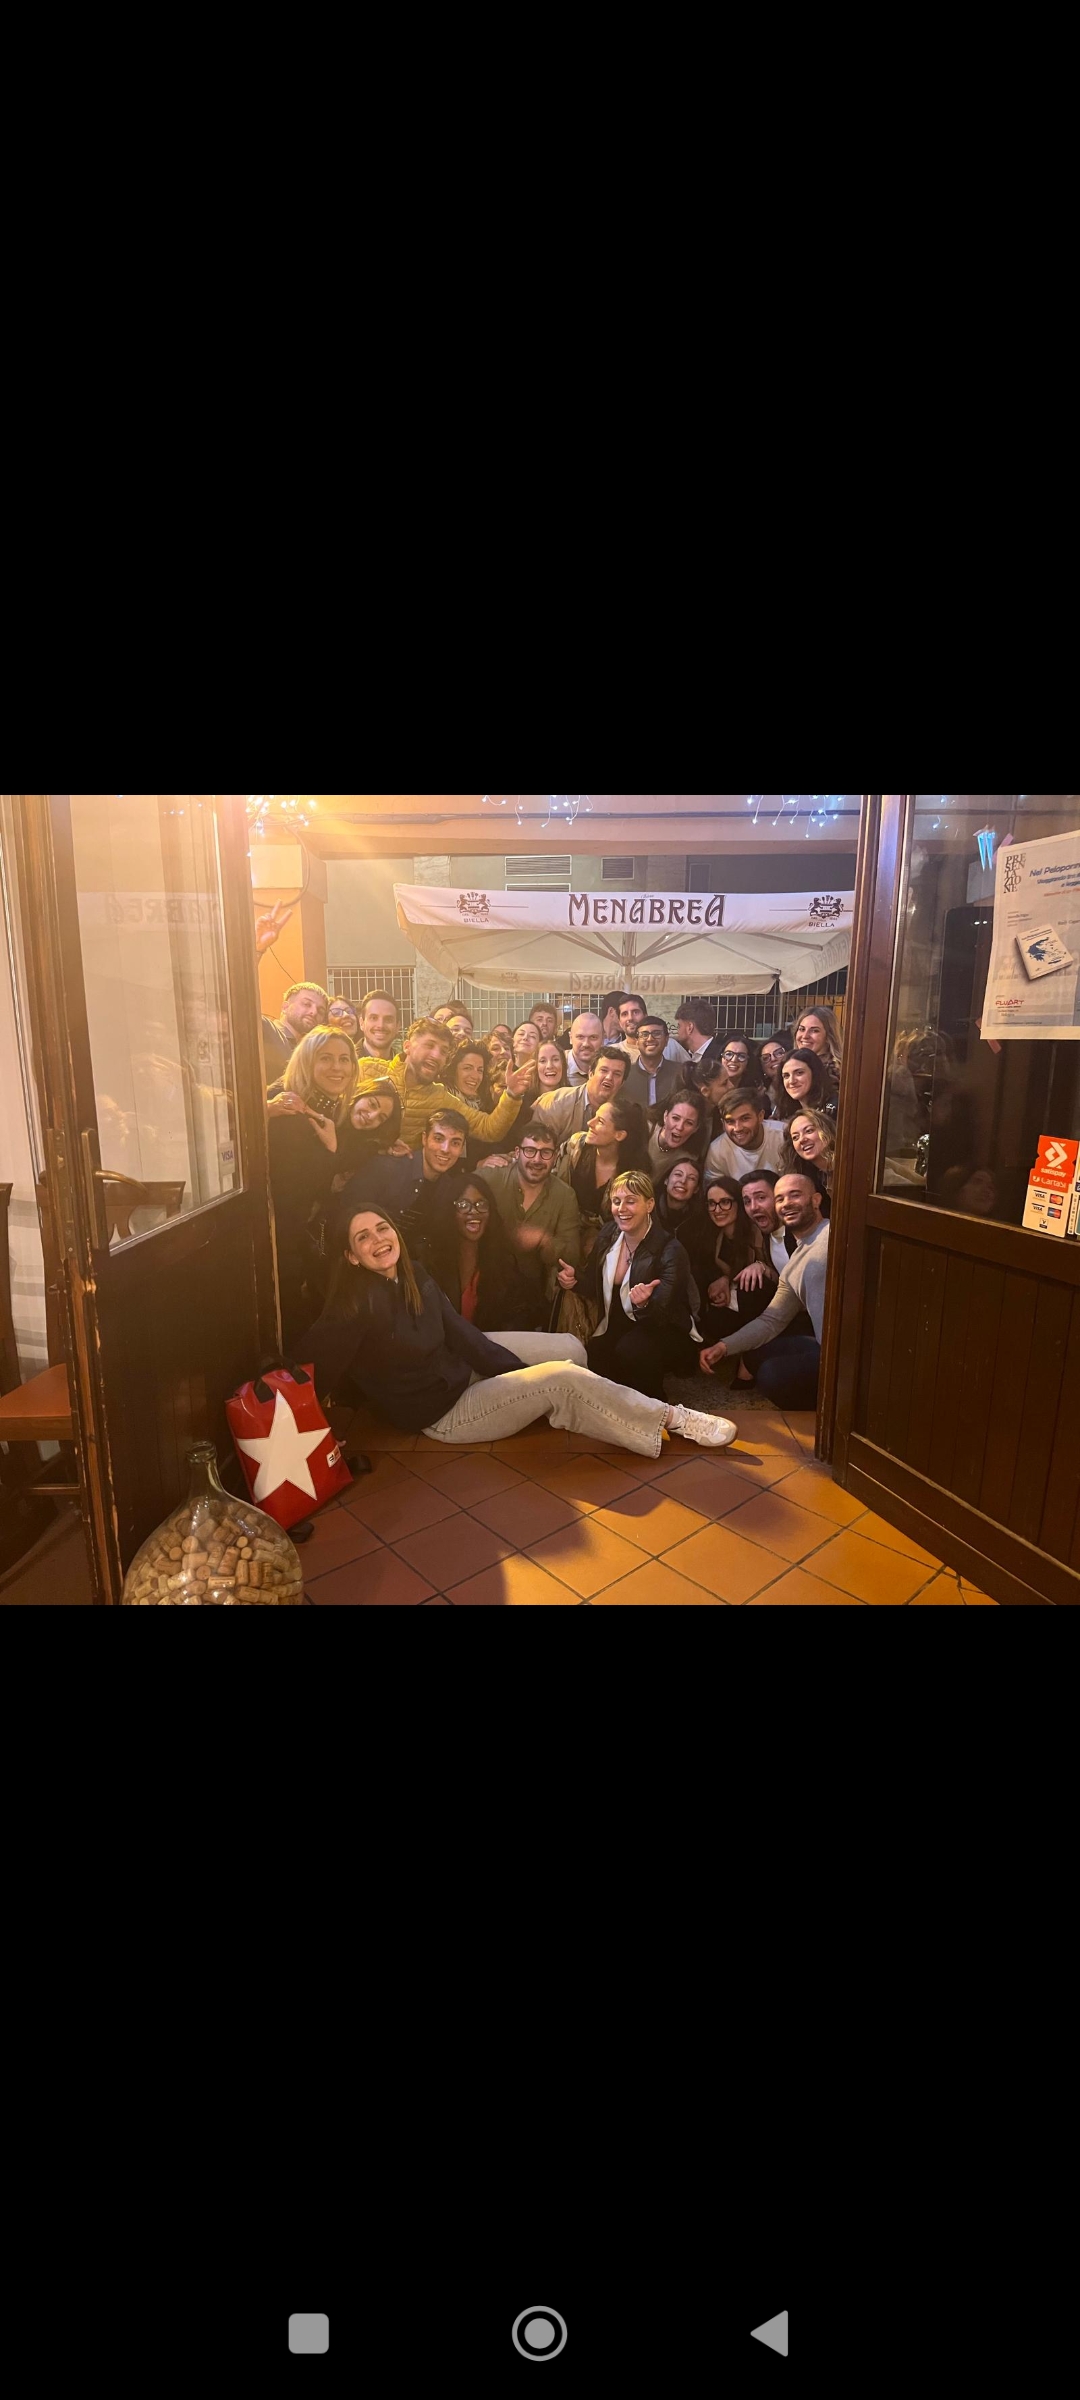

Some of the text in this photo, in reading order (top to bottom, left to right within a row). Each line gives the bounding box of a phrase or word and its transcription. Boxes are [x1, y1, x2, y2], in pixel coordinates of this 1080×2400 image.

[1006, 853, 1026, 863] PRE
[1029, 868, 1043, 877] Nel
[568, 893, 726, 927] MENABREA
[220, 1150, 233, 1162] VISA
[1040, 1168, 1067, 1178] satispay
